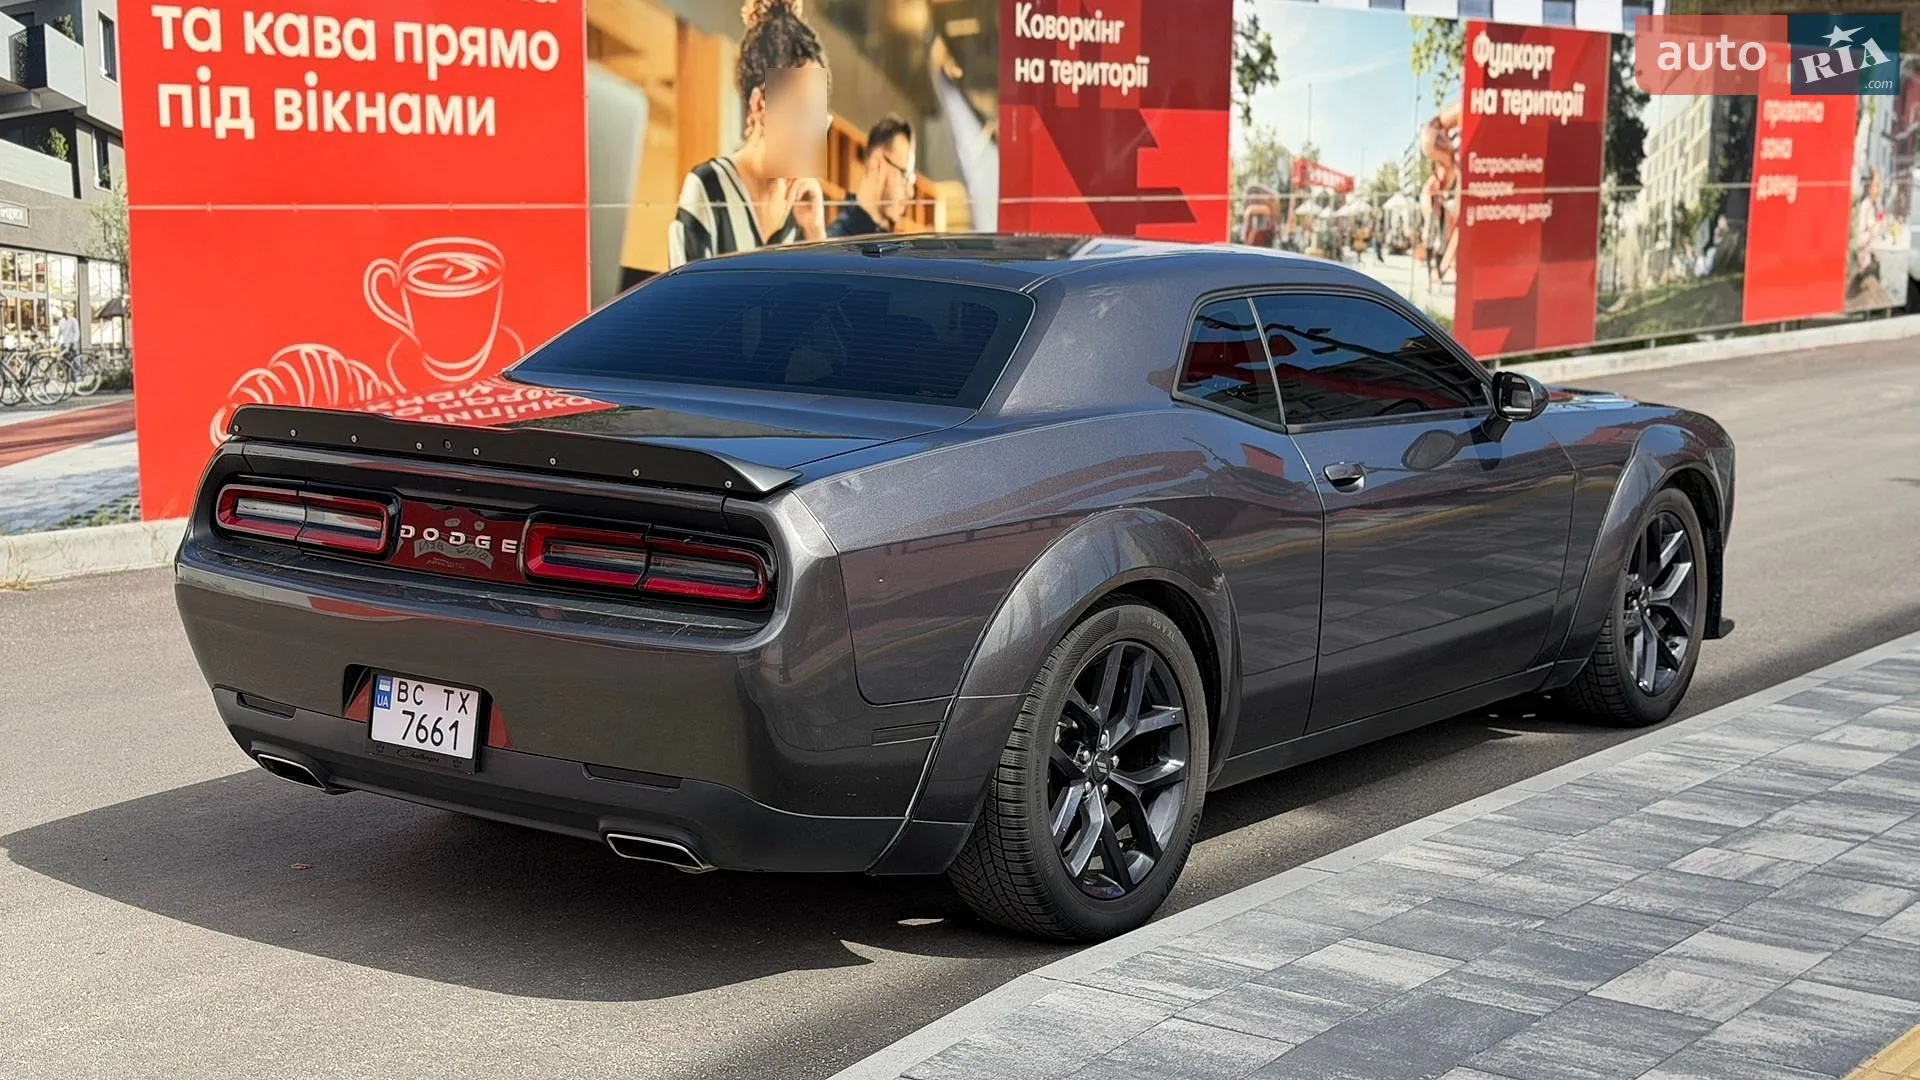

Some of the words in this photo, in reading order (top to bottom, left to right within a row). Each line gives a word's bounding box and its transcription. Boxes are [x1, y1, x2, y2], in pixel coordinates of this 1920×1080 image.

[151, 5, 222, 53] та
[243, 11, 376, 61] кава
[394, 21, 560, 81] прямо
[1015, 2, 1125, 50] Коворкінг
[1014, 57, 1045, 83] на
[1050, 55, 1150, 96] території
[1472, 30, 1555, 80] Фудкорт
[158, 65, 255, 140] під
[274, 71, 497, 137] вікнами
[1470, 87, 1498, 115] на
[1501, 82, 1586, 125] території
[400, 524, 518, 554] DODGE
[377, 694, 389, 707] UA
[397, 681, 424, 706] BC
[443, 689, 470, 715] TX
[401, 710, 459, 750] 7661
